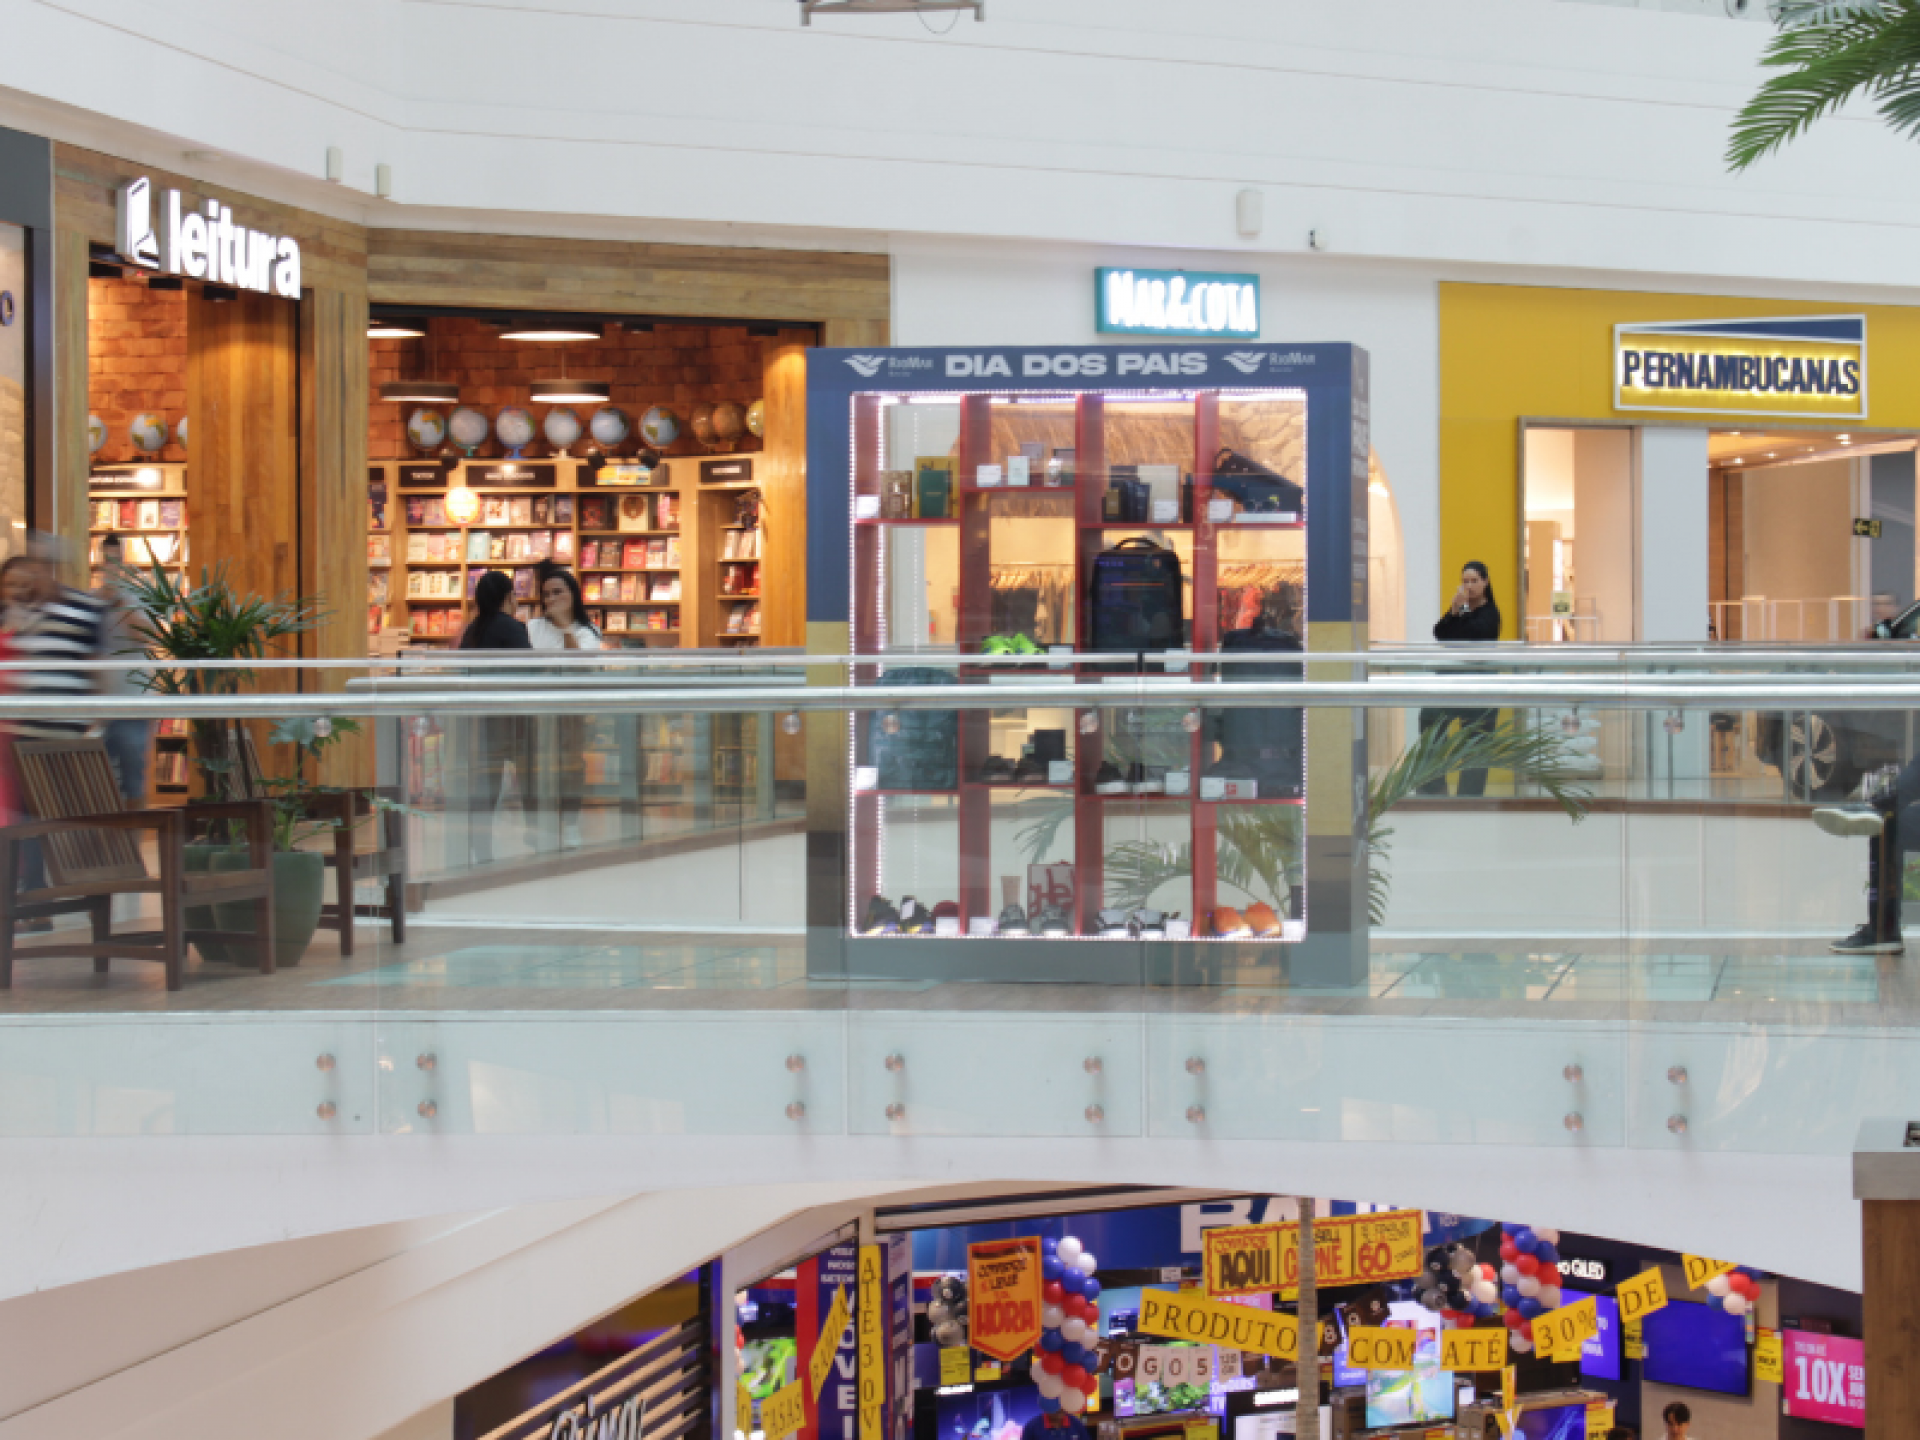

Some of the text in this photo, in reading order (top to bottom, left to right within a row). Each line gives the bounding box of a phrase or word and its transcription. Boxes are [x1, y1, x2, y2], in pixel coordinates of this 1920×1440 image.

[167, 189, 300, 300] leitura
[945, 352, 1207, 377] DIA DOS PAIS
[1622, 350, 1860, 395] PERNAMBUCANAS
[1219, 1249, 1271, 1290] AQUI
[1622, 1279, 1661, 1315] DE
[1350, 1332, 1502, 1366] COM ATÉ
[1538, 1305, 1595, 1351] 30%
[1794, 1355, 1847, 1407] 10X
